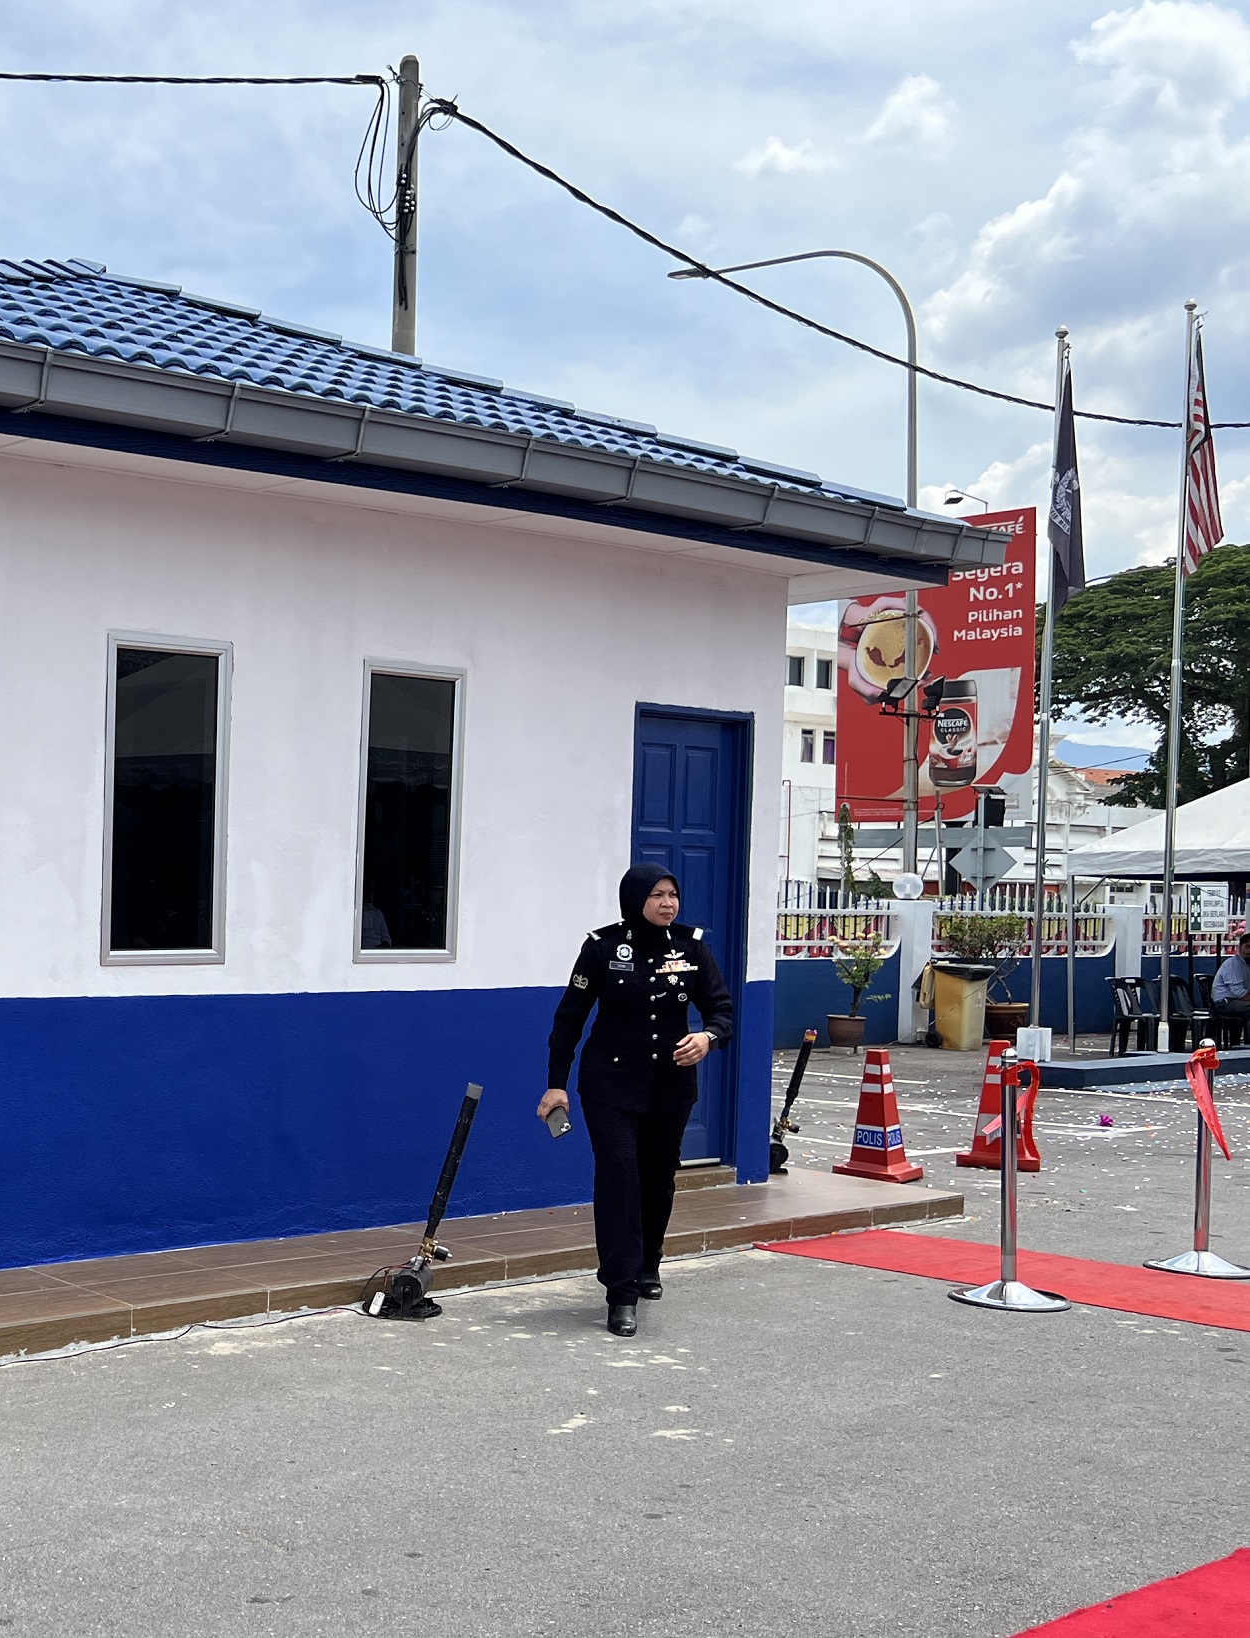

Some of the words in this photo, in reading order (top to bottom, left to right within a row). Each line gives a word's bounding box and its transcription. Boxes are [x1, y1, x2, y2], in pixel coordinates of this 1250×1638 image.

[951, 561, 1023, 582] Segera
[968, 609, 1023, 623] Pilihan
[953, 624, 1023, 642] Malaysia
[856, 1130, 883, 1146] POLIS
[887, 1130, 901, 1146] POLIS
